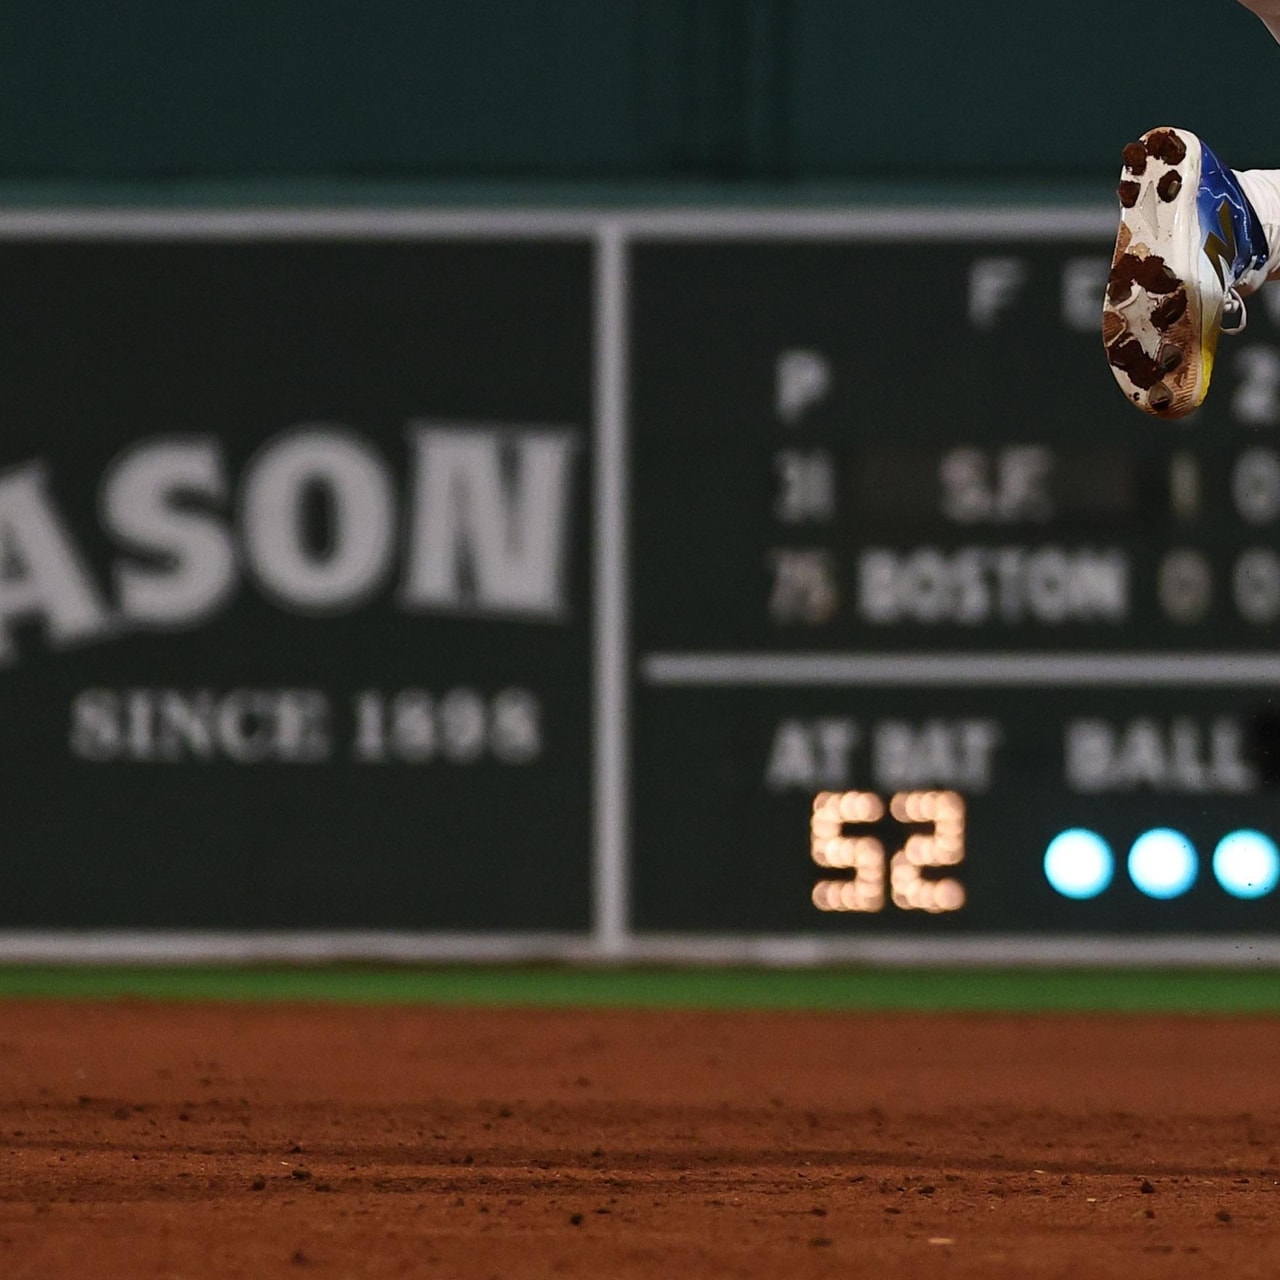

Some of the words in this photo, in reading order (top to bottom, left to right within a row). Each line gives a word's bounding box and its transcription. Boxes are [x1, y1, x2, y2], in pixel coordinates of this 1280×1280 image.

[778, 351, 828, 417] P
[0, 428, 573, 658] ASON
[860, 549, 1127, 621] BOSTON
[1159, 550, 1211, 621] 0
[73, 691, 327, 759] SINCE
[769, 720, 855, 788] AT
[875, 721, 995, 788] BAT
[1067, 720, 1251, 791] BALL
[811, 790, 964, 912] 52
